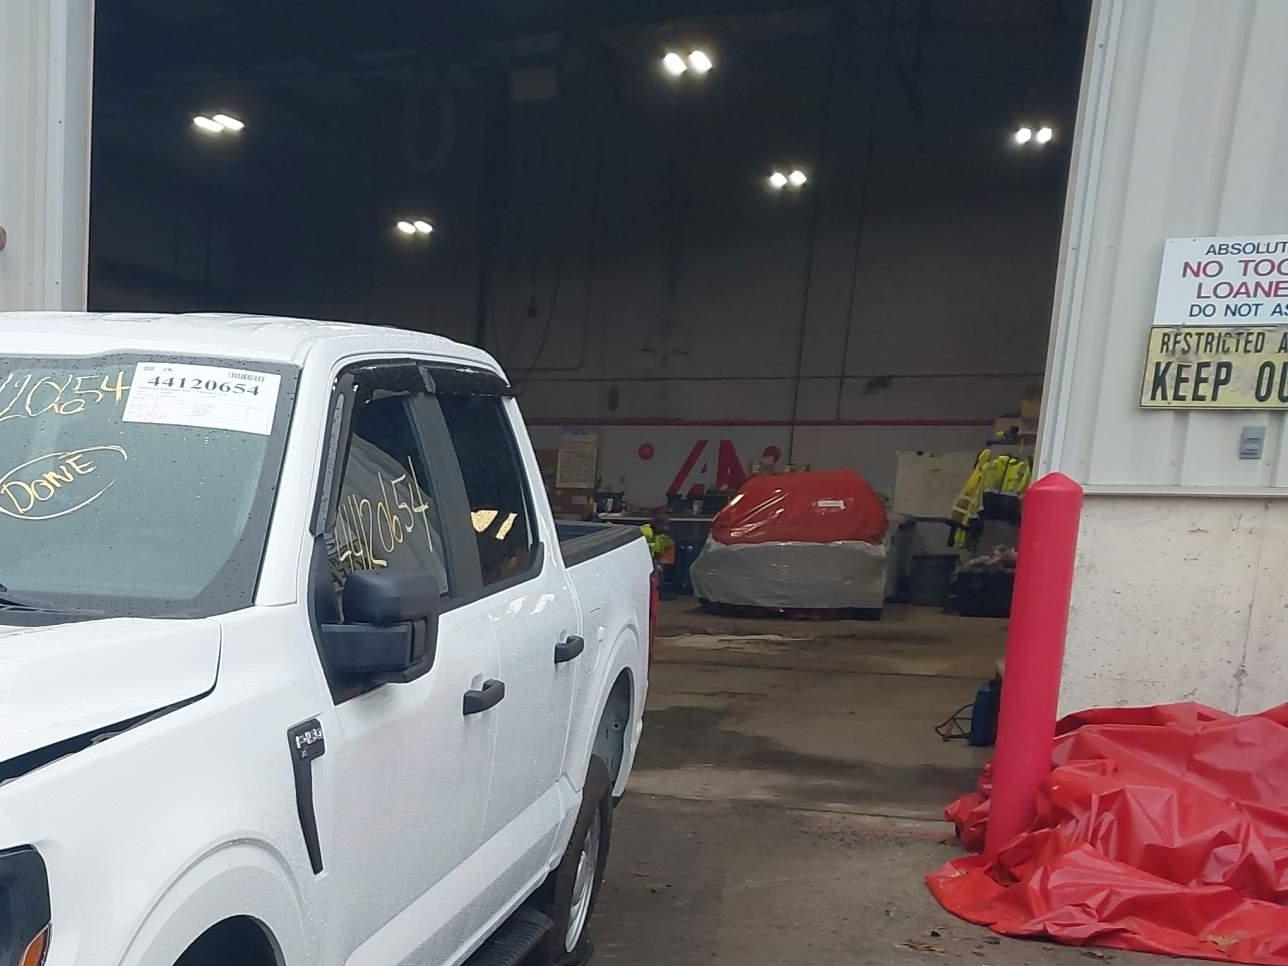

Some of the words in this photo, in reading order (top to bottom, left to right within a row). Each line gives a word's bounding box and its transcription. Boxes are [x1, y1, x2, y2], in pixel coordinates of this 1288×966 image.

[1183, 261, 1223, 278] NO
[1189, 304, 1217, 317] DO
[1224, 303, 1264, 317] NOT
[1160, 332, 1265, 353] RESTRICTED
[147, 376, 260, 396] 44120654
[1150, 361, 1233, 401] KEEP
[0, 454, 97, 514] DONE
